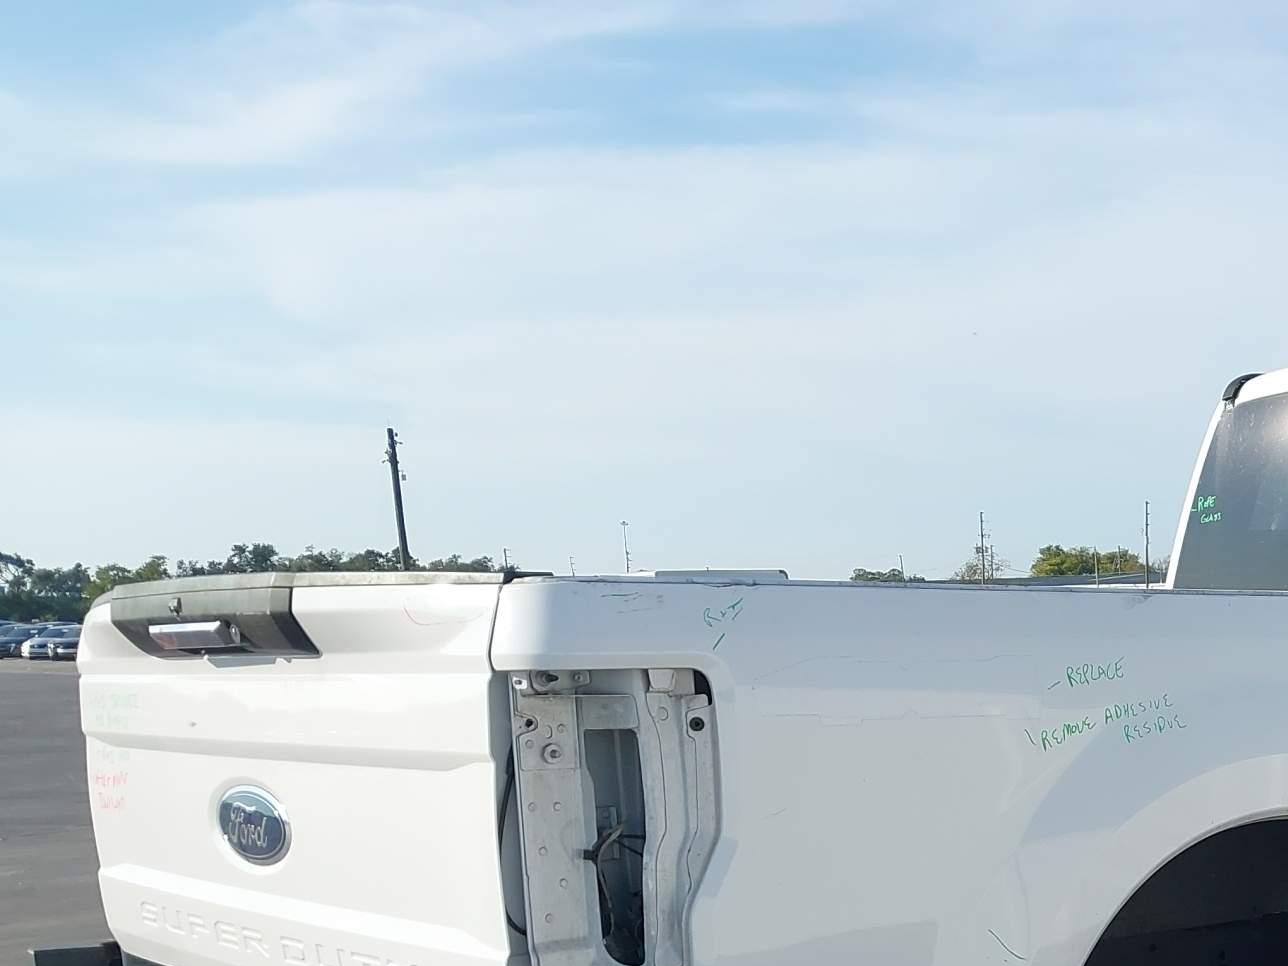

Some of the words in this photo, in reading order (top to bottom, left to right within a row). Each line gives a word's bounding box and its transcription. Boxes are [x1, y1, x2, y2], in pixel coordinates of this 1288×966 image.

[1066, 656, 1125, 688] REPLACE
[1040, 716, 1097, 752] REMOVE
[1104, 694, 1174, 725] ADHESIVE
[1123, 714, 1188, 744] RESIDUE
[229, 800, 270, 849] Ford
[139, 899, 271, 959] SUPER
